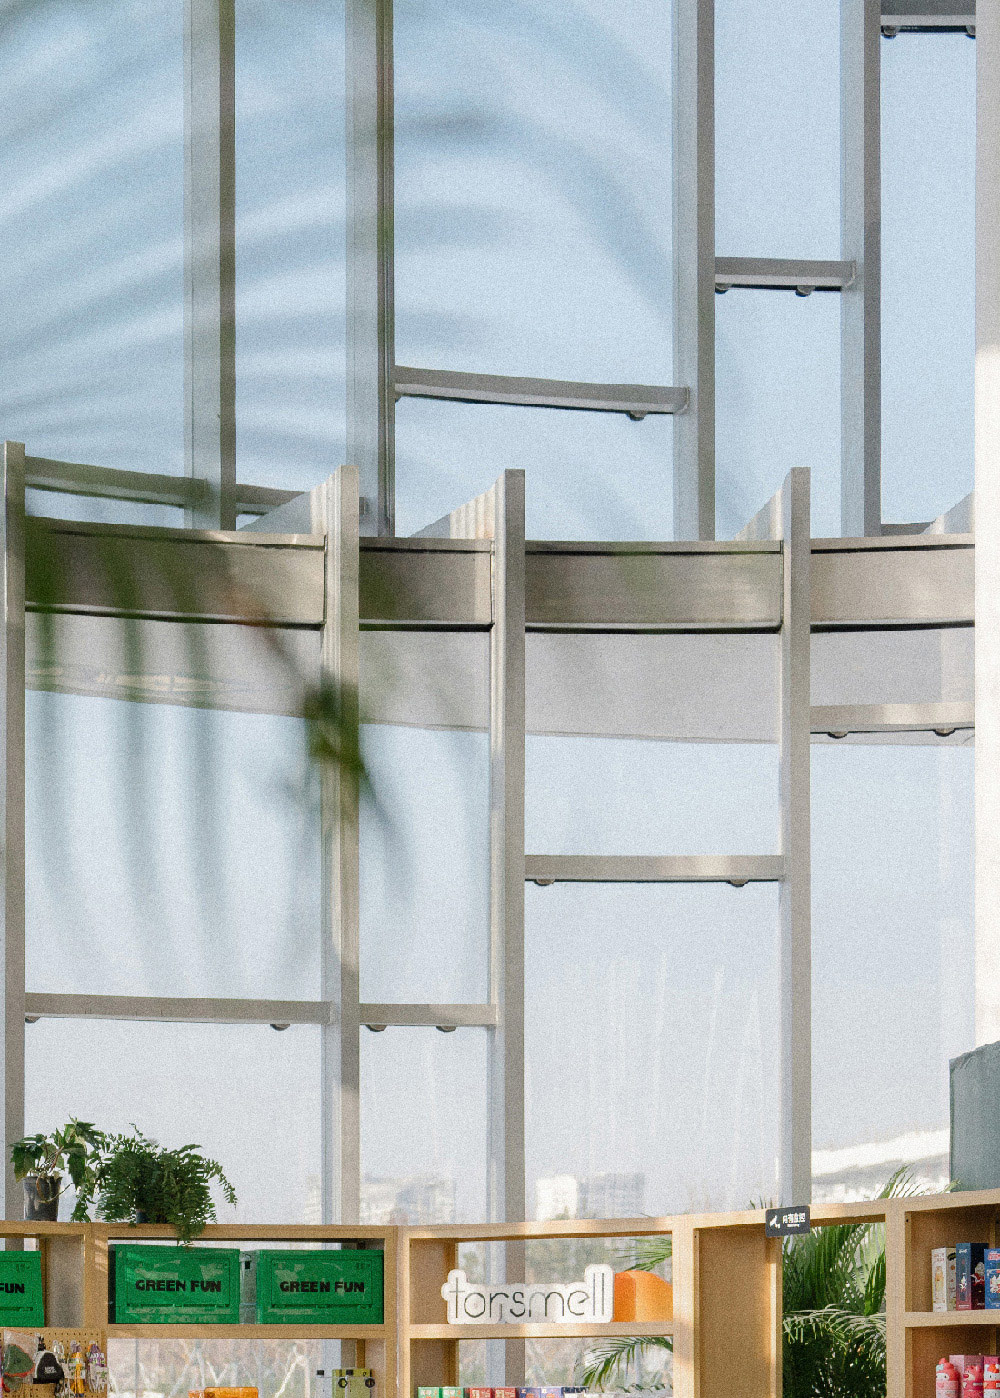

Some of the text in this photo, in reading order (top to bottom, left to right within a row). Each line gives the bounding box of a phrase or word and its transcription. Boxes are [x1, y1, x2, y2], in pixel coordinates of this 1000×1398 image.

[135, 1279, 222, 1292] GREEN FUN
[279, 1281, 365, 1293] GREEN FUN
